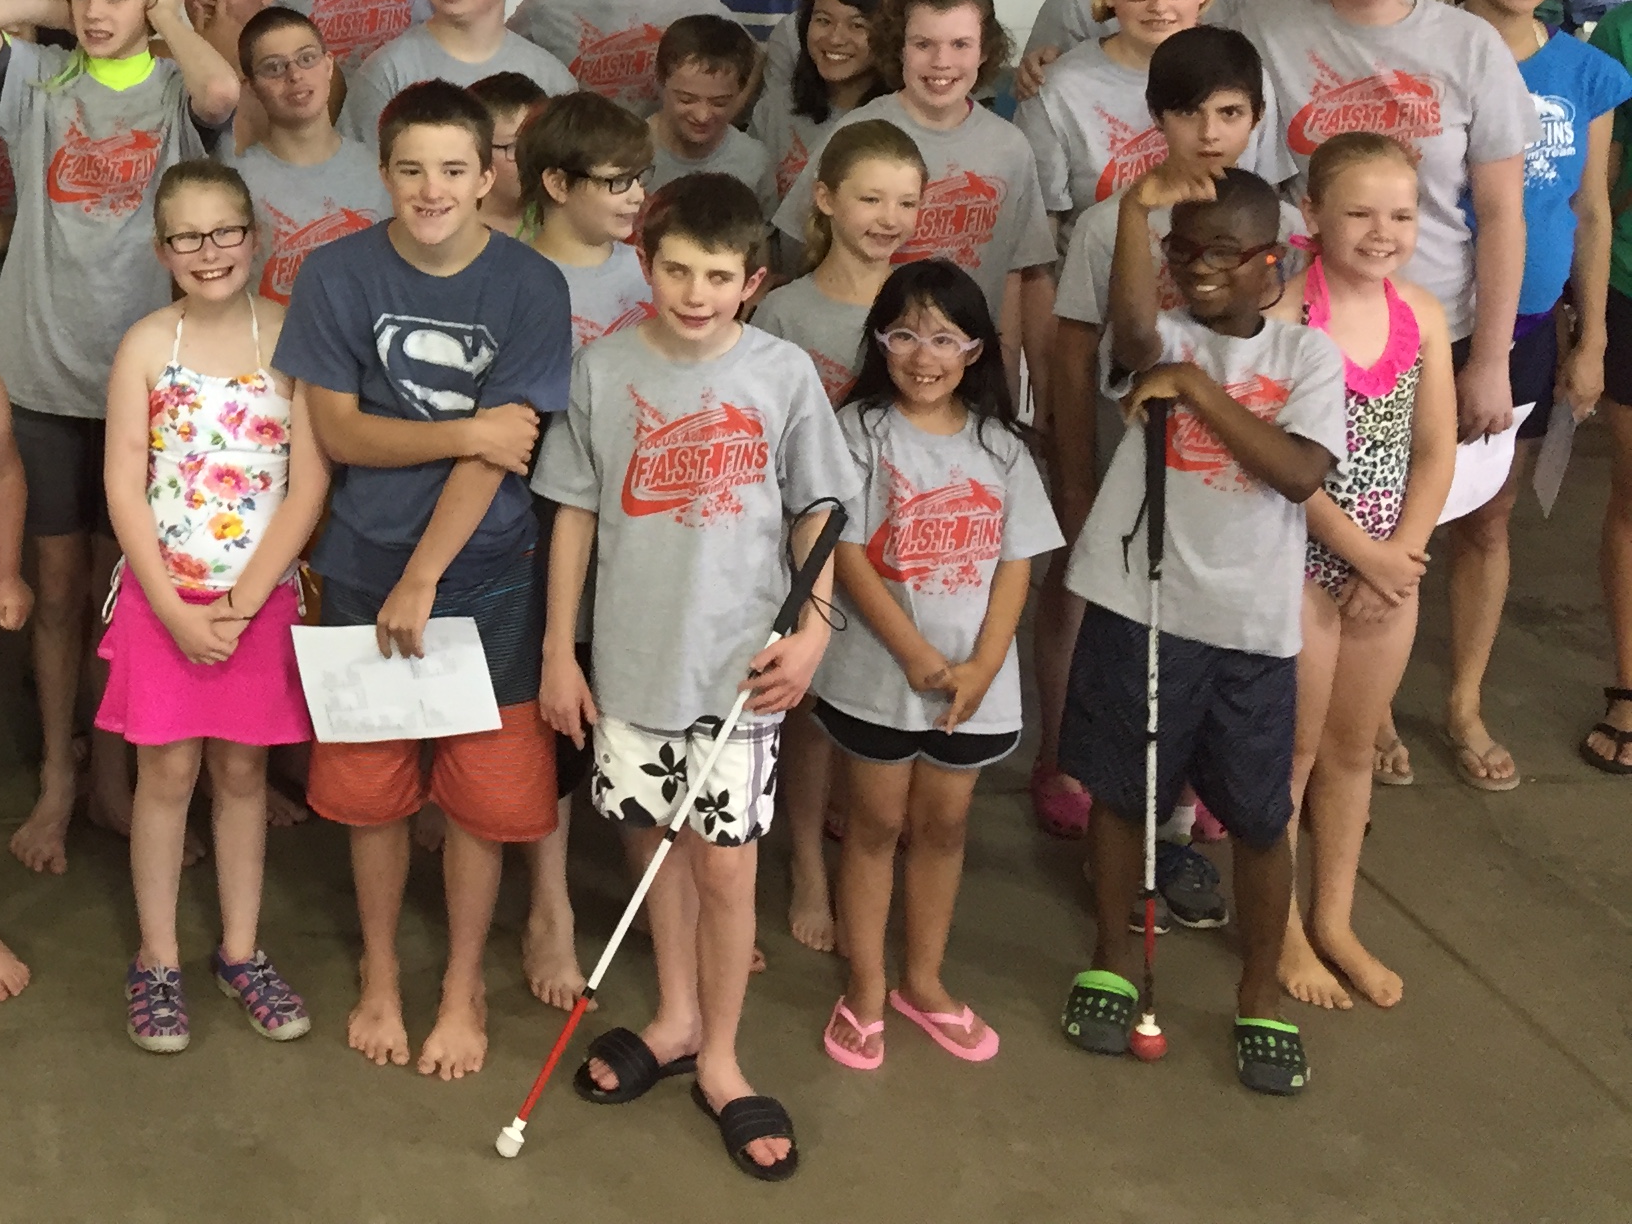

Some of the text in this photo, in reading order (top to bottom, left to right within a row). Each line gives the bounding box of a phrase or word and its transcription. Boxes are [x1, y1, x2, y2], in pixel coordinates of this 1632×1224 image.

[1398, 101, 1441, 127] FINS
[1541, 121, 1575, 146] INS
[638, 433, 679, 451] FOCUS
[632, 441, 769, 490] F.A.S.T. FINS
